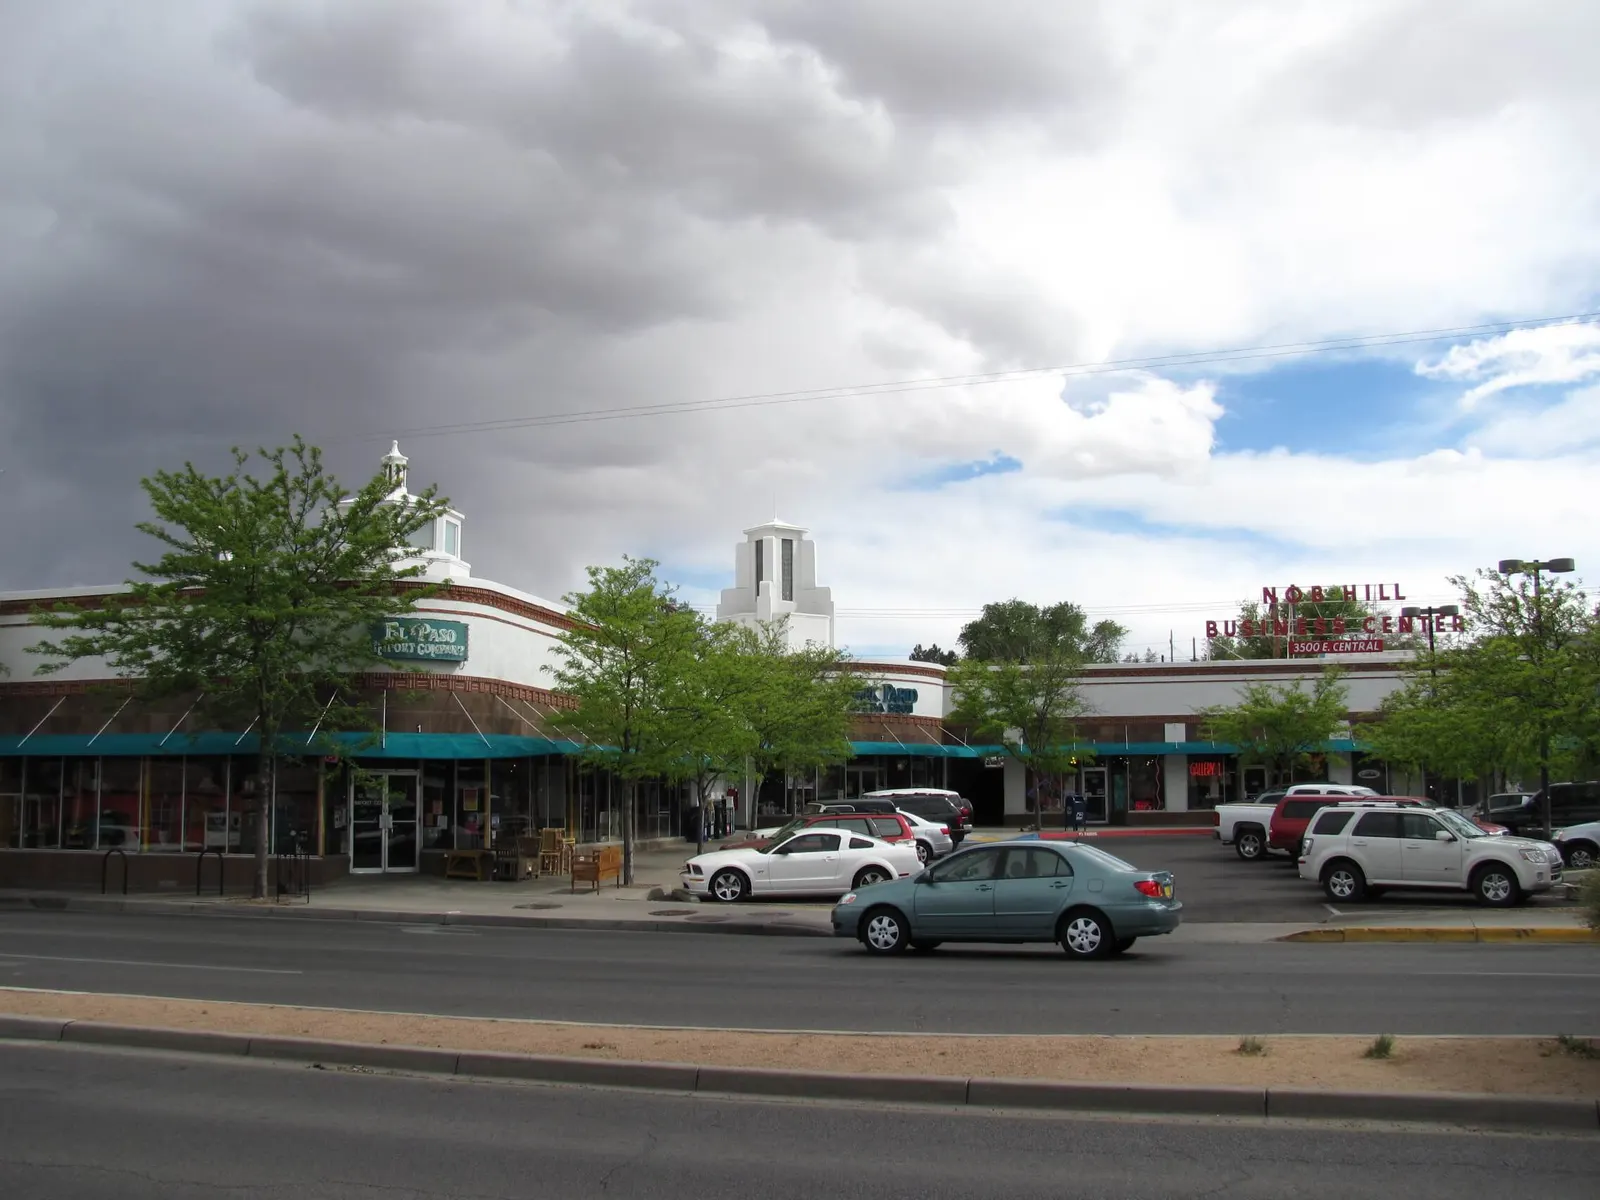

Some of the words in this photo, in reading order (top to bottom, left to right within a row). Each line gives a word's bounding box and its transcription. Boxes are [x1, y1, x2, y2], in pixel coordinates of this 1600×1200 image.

[1263, 584, 1324, 604] NOB
[1343, 583, 1406, 601] HILL
[1206, 616, 1346, 638] BUSINESS
[1363, 615, 1465, 634] CENTER
[1293, 642, 1320, 653] 3500
[1322, 642, 1331, 652] E.
[1332, 641, 1380, 652] CENTRAL
